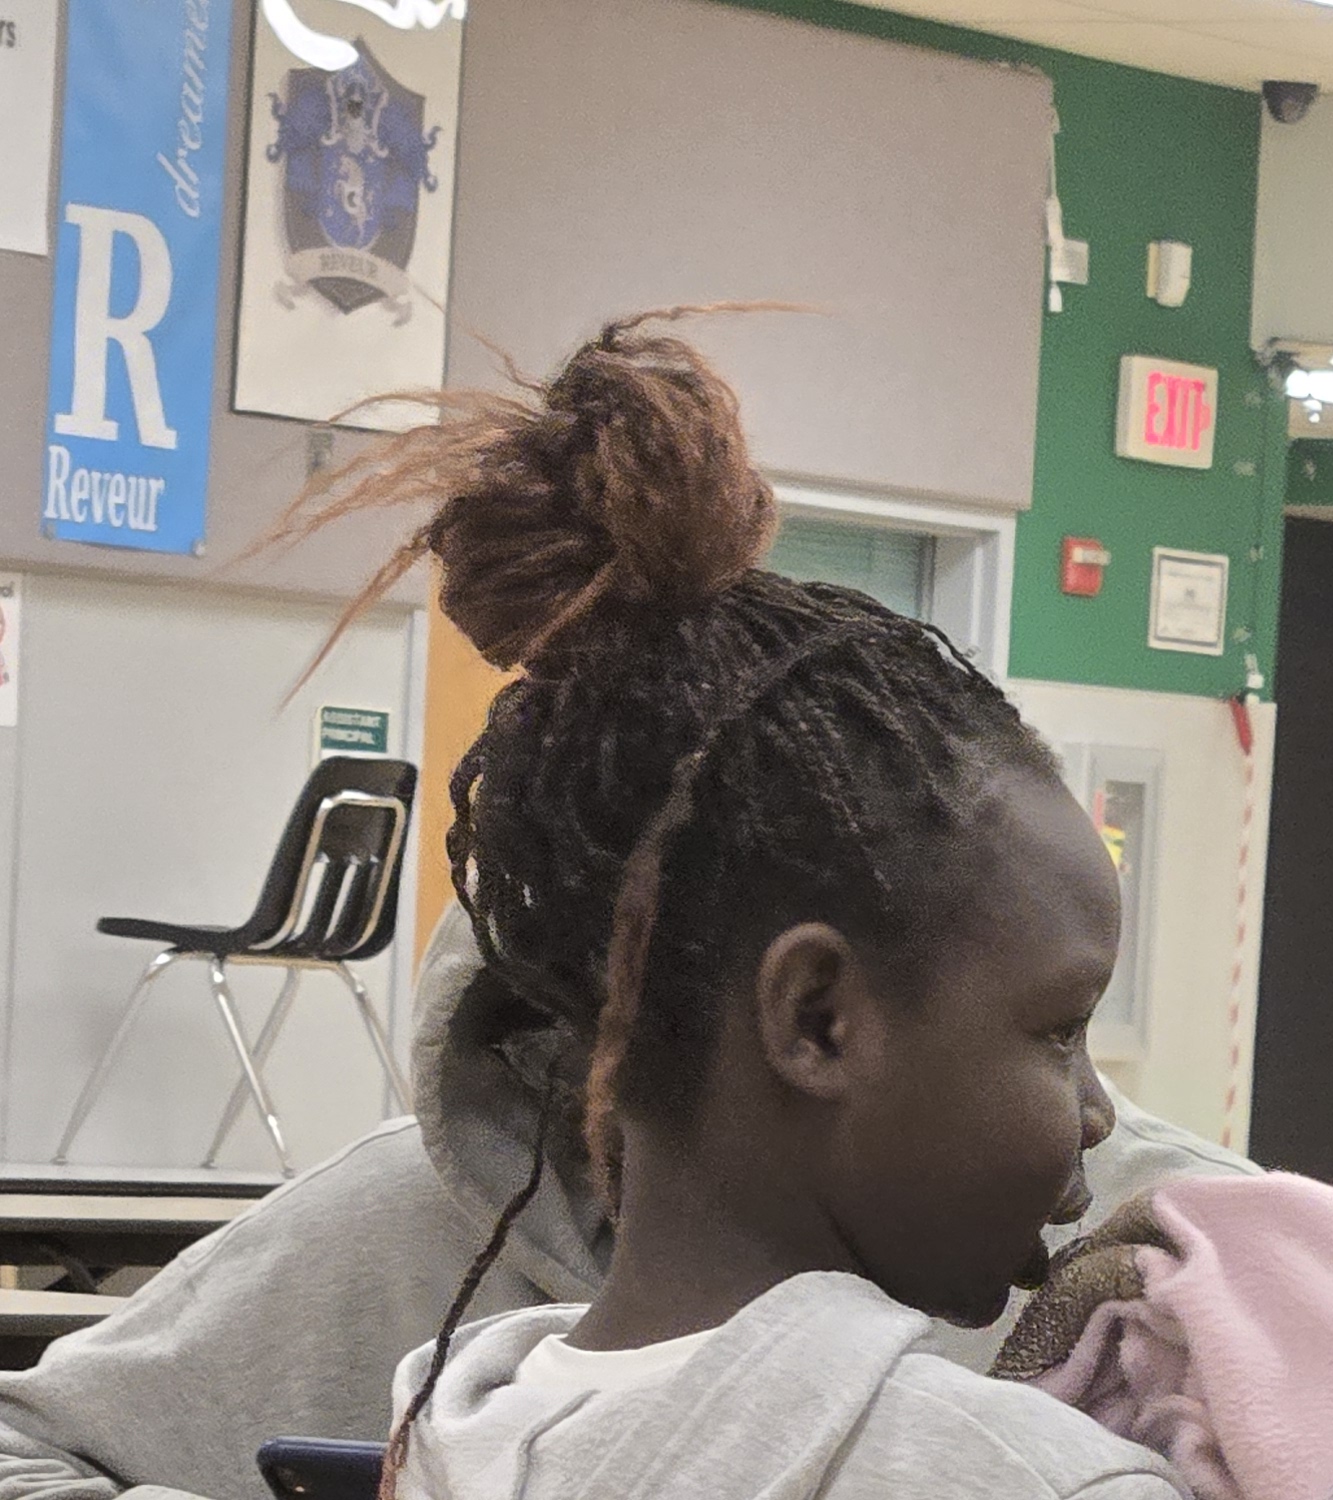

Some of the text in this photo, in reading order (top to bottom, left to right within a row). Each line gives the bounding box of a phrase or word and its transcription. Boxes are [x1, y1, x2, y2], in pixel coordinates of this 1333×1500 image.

[55, 202, 178, 450] R
[1144, 371, 1211, 450] EXIT
[44, 446, 165, 532] Reveur
